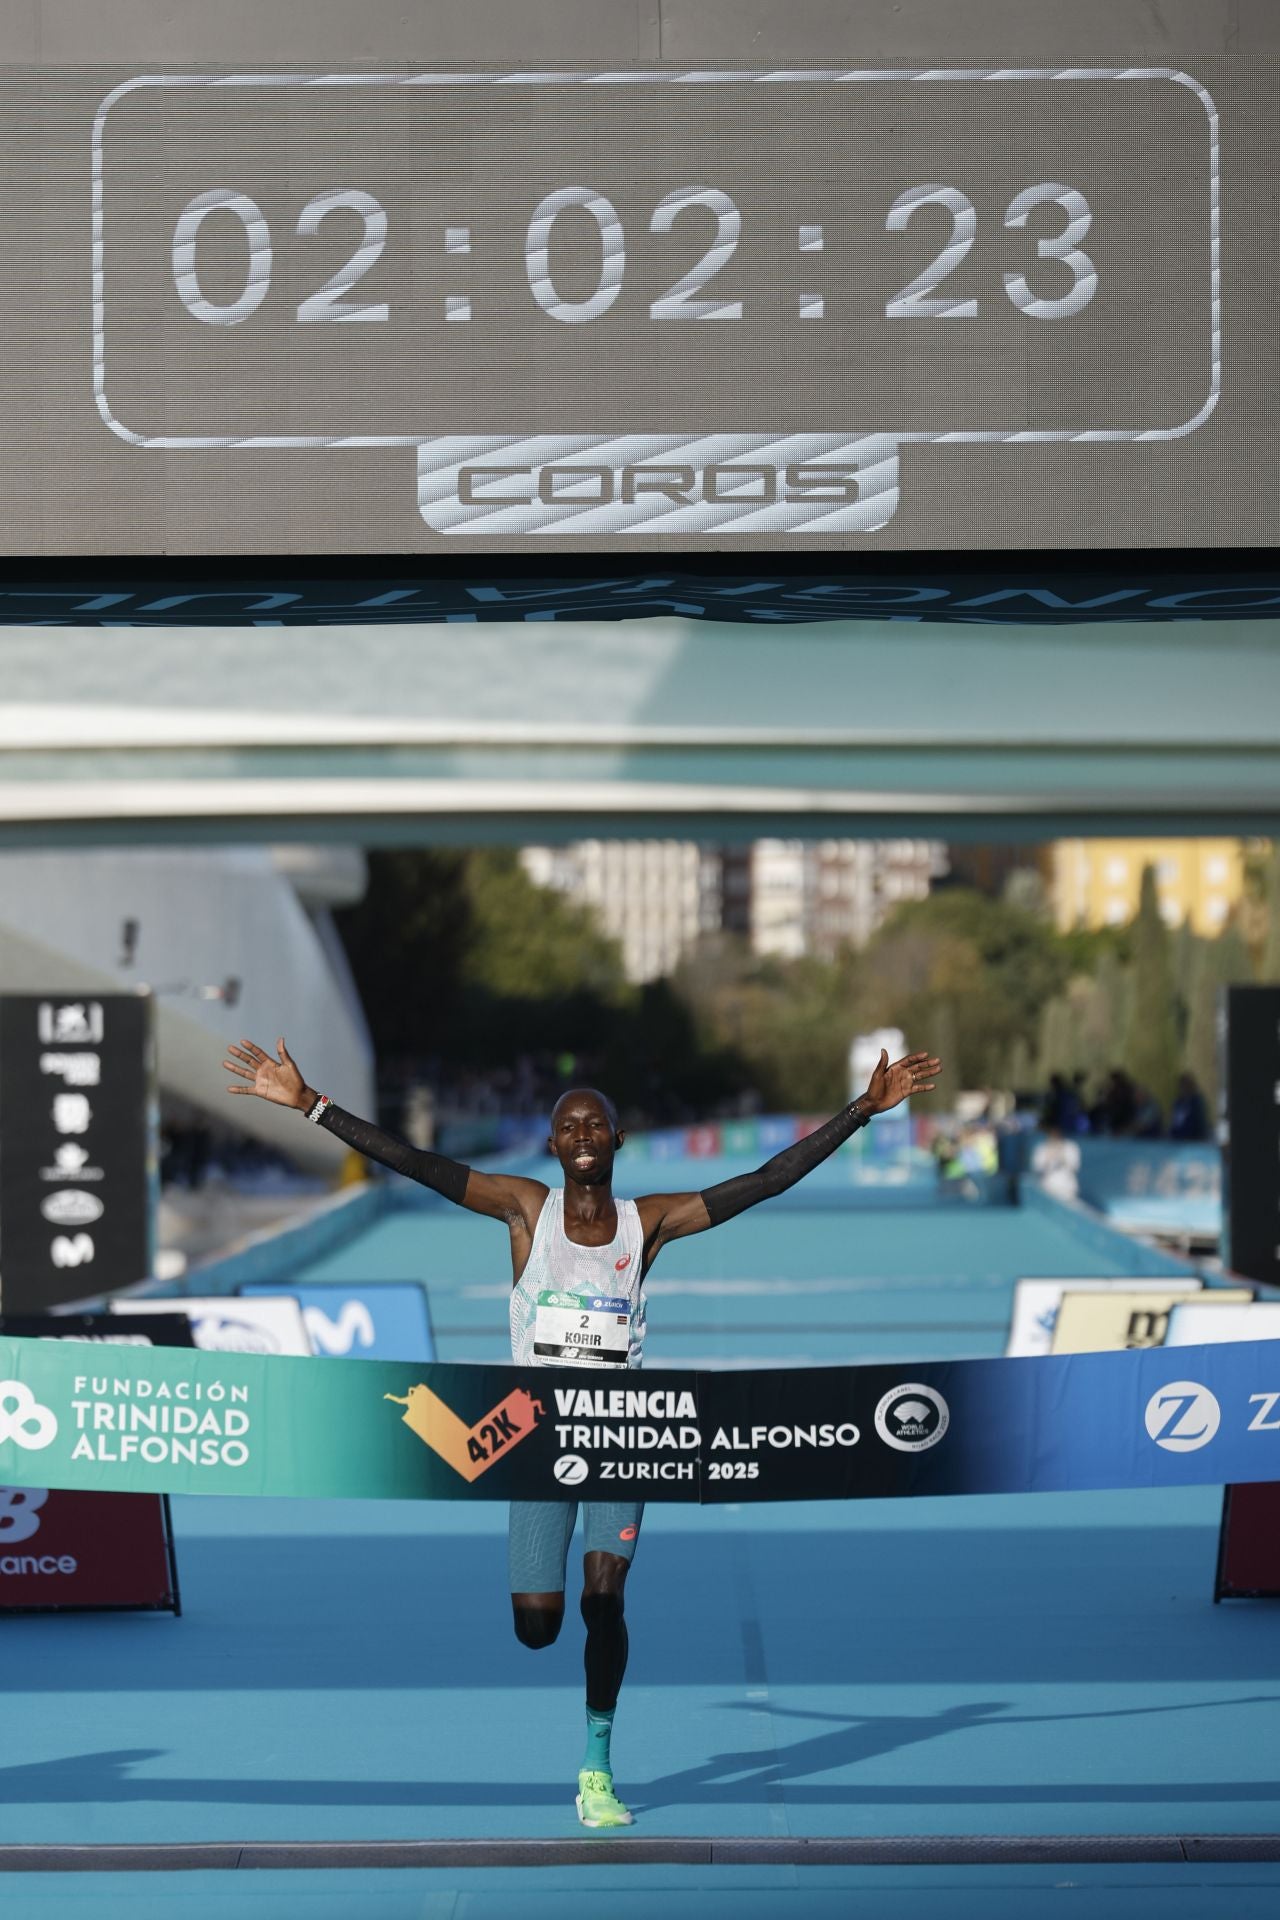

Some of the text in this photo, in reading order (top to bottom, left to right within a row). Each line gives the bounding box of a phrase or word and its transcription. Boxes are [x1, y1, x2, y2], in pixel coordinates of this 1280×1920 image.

[457, 464, 860, 507] COROS
[579, 1315, 589, 1329] 2
[564, 1331, 602, 1346] KORIR
[74, 1376, 248, 1403] FUNDACIÓN
[554, 1389, 697, 1418] VALENCIA
[71, 1401, 250, 1437] TRINIDAD
[467, 1408, 522, 1463] 42K
[555, 1423, 860, 1450] TRINIDAD ALFONSO
[71, 1433, 250, 1467] ALFONSO
[599, 1461, 694, 1480] ZURICH
[708, 1462, 760, 1480] 2025
[0, 1555, 77, 1575] ance
